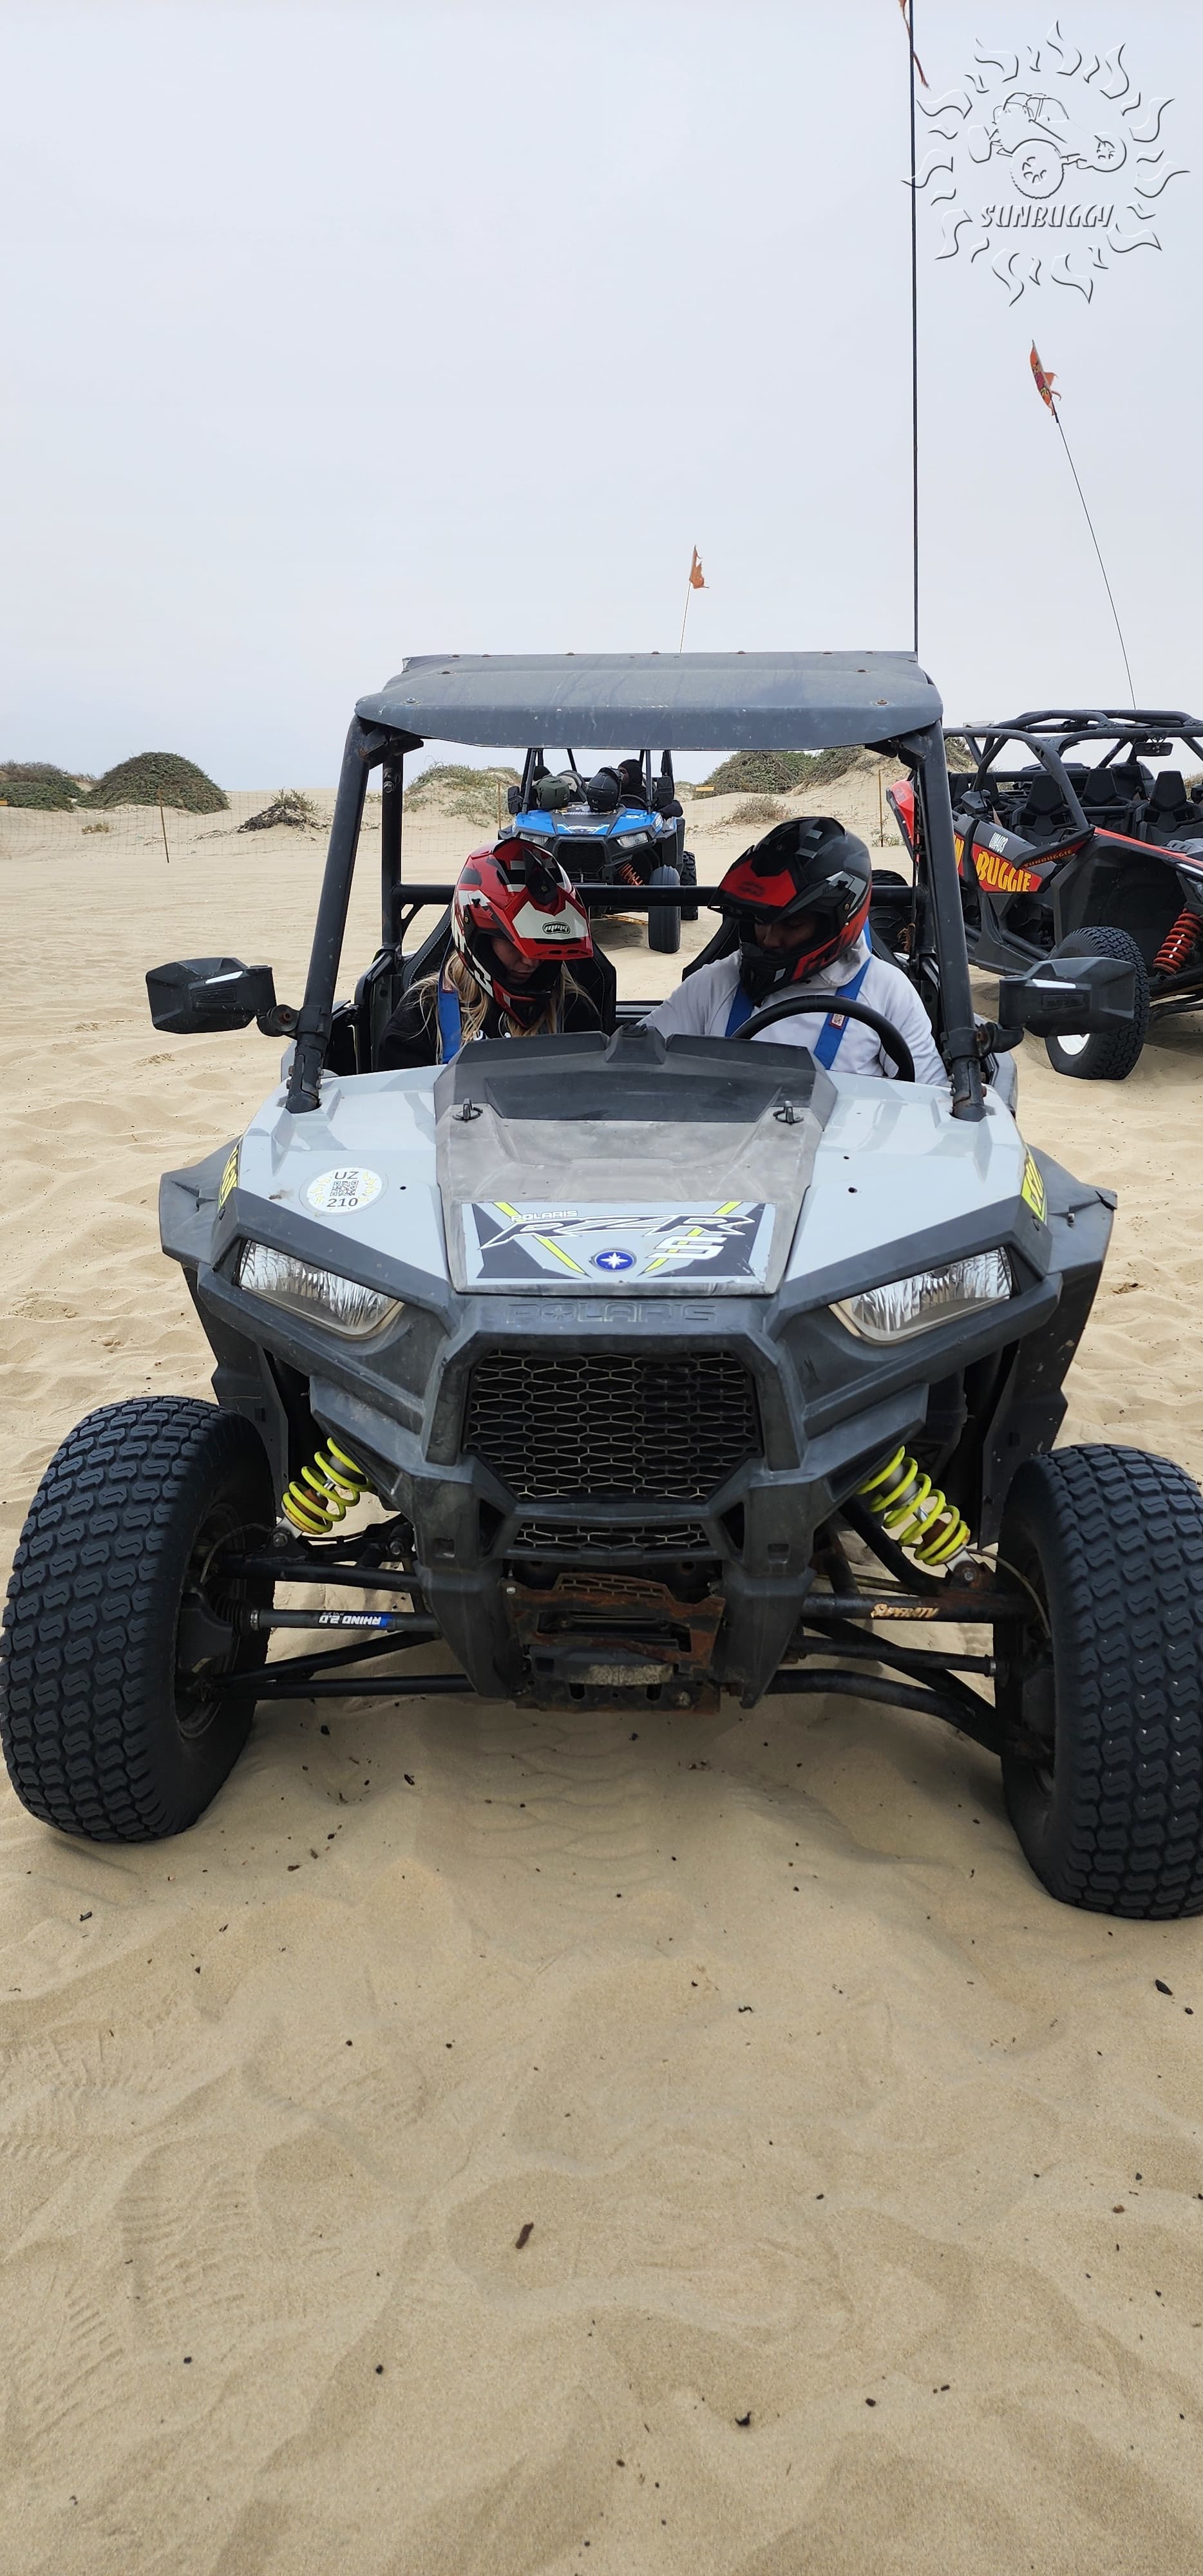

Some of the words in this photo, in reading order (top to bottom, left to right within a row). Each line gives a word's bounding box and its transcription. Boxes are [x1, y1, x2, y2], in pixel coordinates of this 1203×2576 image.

[976, 851, 1032, 891] BUGGIE
[334, 1171, 359, 1180] UZ
[326, 1197, 359, 1208] 210
[511, 1210, 578, 1222] POLARIS
[478, 1214, 756, 1250] RZR
[645, 1235, 728, 1260] S
[506, 1302, 717, 1324] POLARIS
[318, 1615, 341, 1624] 2.0
[341, 1615, 382, 1625] RHINO
